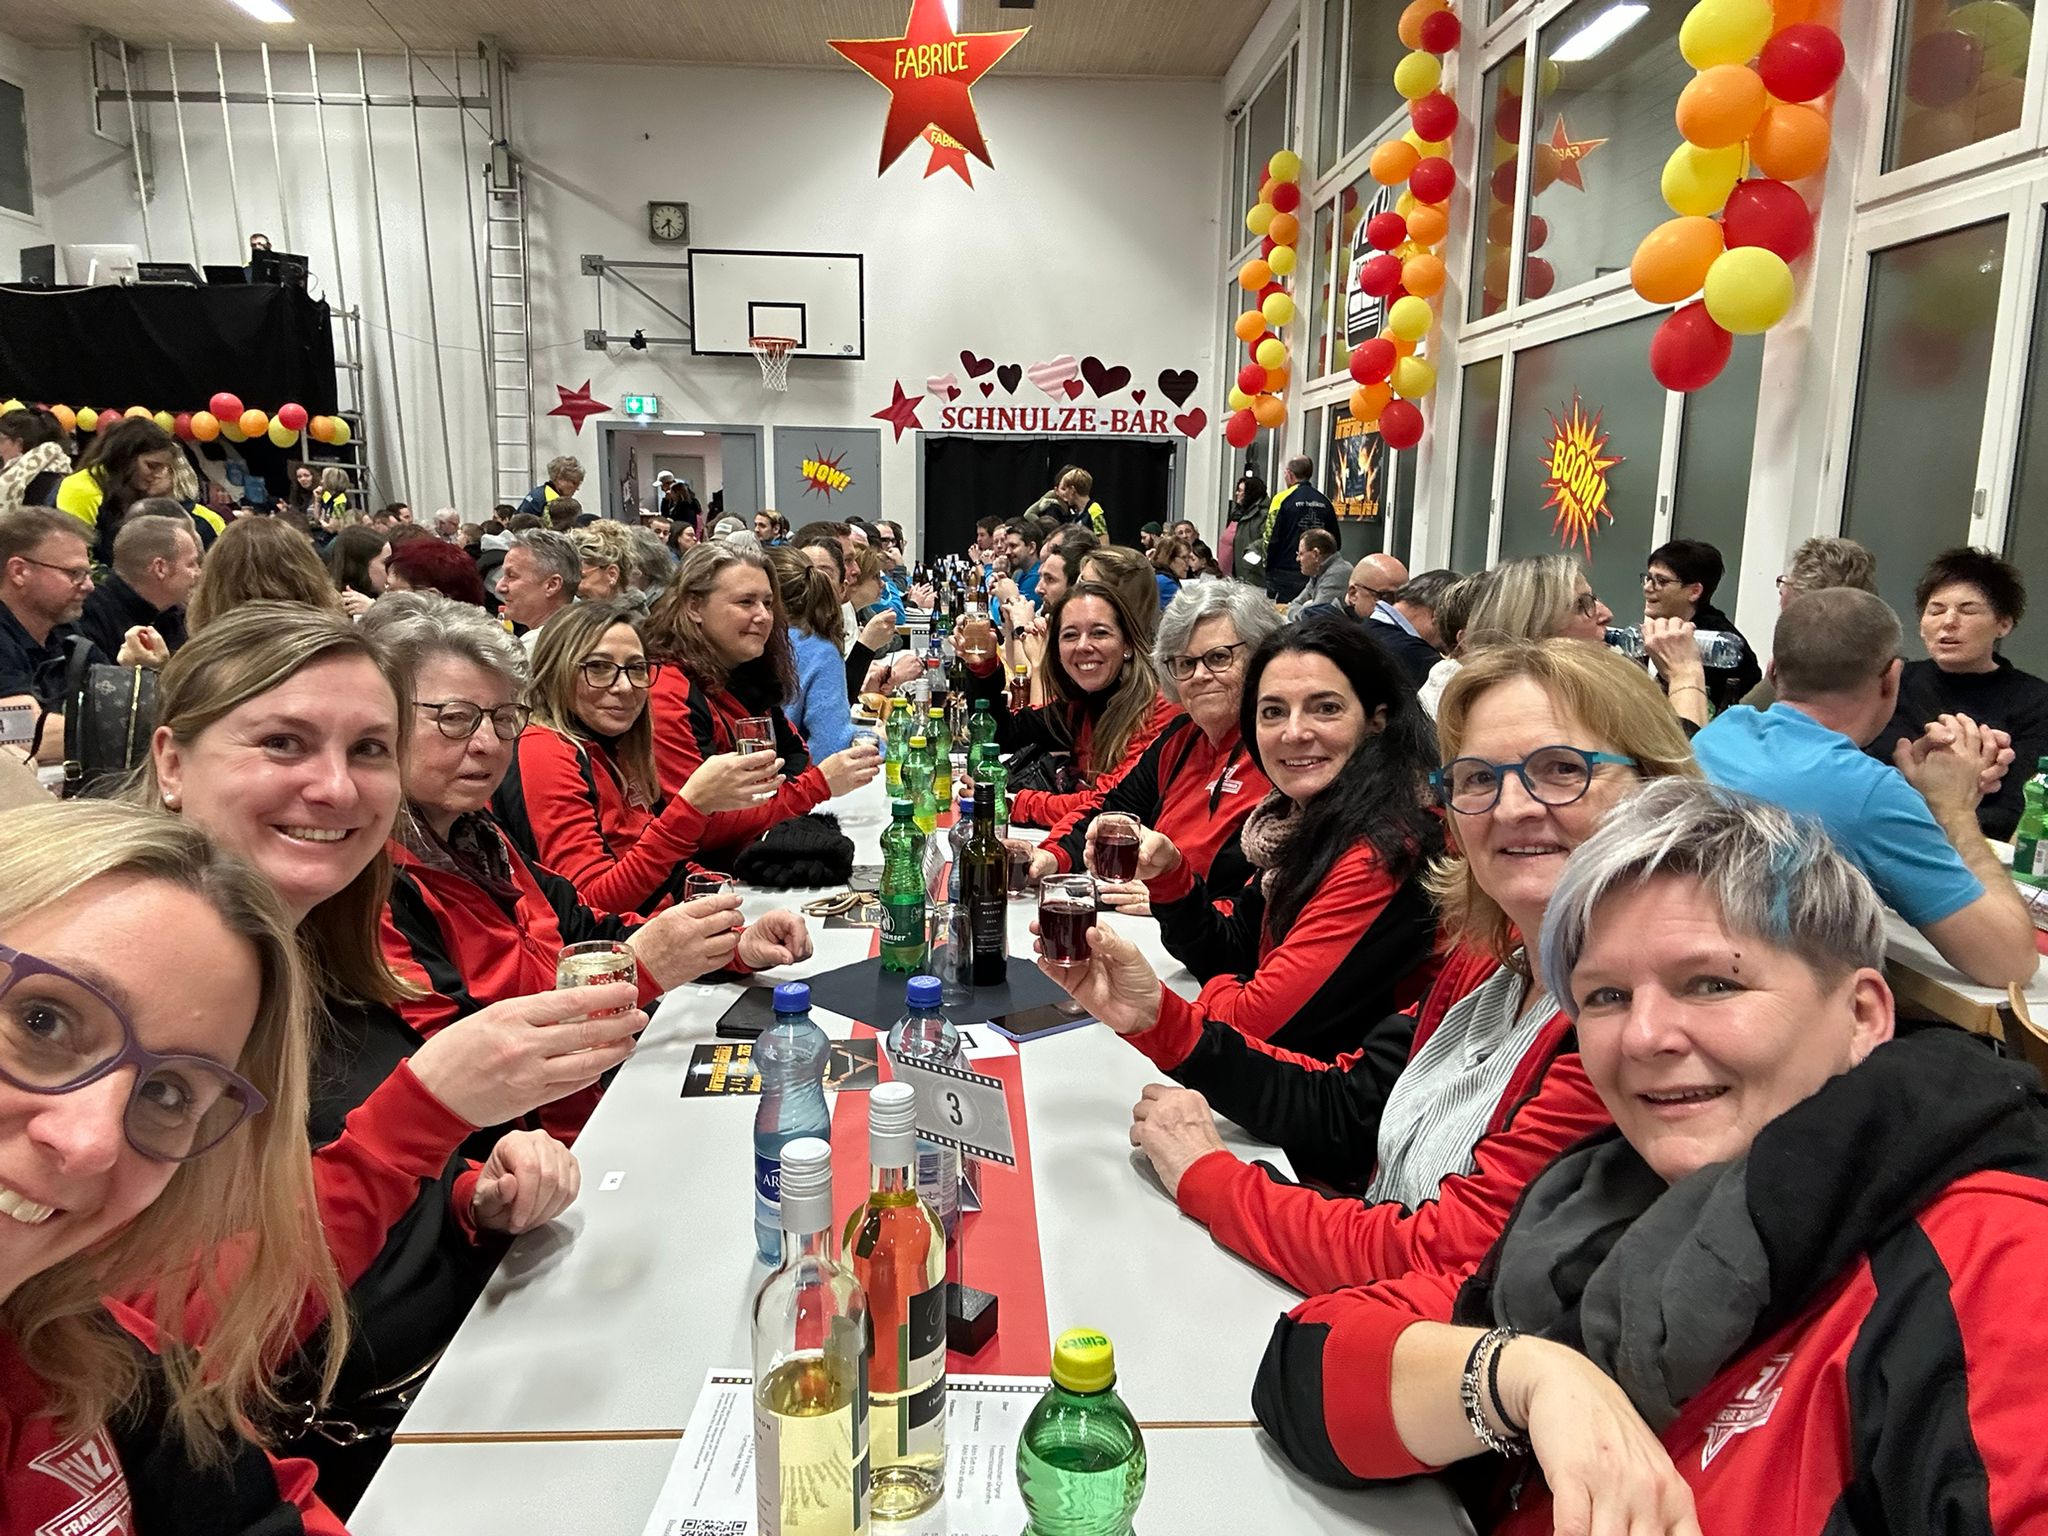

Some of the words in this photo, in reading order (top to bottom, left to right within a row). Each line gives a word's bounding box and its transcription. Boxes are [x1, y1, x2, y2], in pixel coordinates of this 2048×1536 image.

[895, 41, 968, 79] FABRICE
[941, 407, 1170, 434] SCHNULZE-BAR
[802, 459, 851, 492] WOW!
[1551, 439, 1607, 524] BOOM!
[946, 1092, 963, 1126] 3
[762, 1173, 781, 1188] AR
